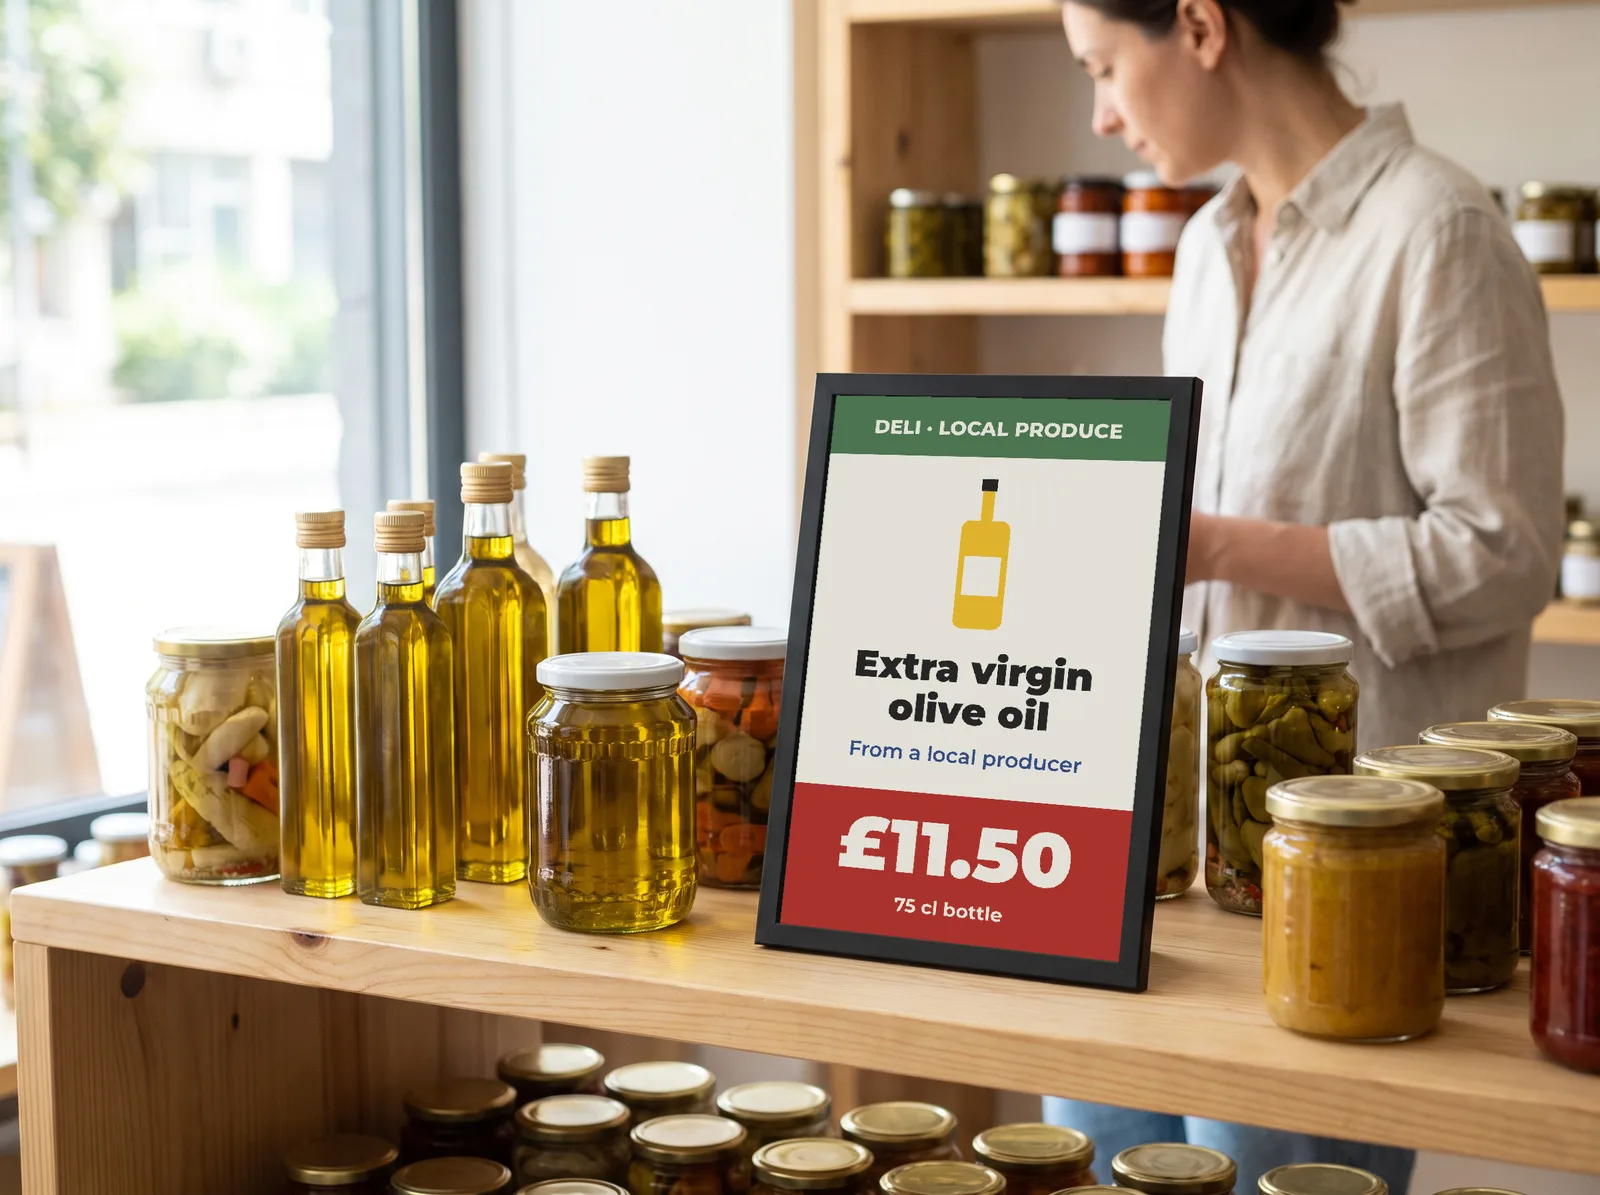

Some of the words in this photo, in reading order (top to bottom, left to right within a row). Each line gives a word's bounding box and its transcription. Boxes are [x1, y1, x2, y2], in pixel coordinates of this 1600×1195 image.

[875, 419, 921, 435] DELI
[939, 420, 1008, 436] LOCAL
[1015, 422, 1124, 440] PRODUCE
[855, 650, 959, 682] Extra
[972, 654, 1093, 697] virgin
[889, 691, 986, 727] olive
[998, 698, 1050, 731] oil
[850, 740, 902, 759] From
[909, 748, 920, 761] a
[928, 746, 976, 766] local
[983, 754, 1082, 774] producer
[839, 815, 1072, 889] £11.50
[894, 897, 916, 914] 75
[921, 901, 938, 916] cl
[944, 902, 1003, 923] bottle
